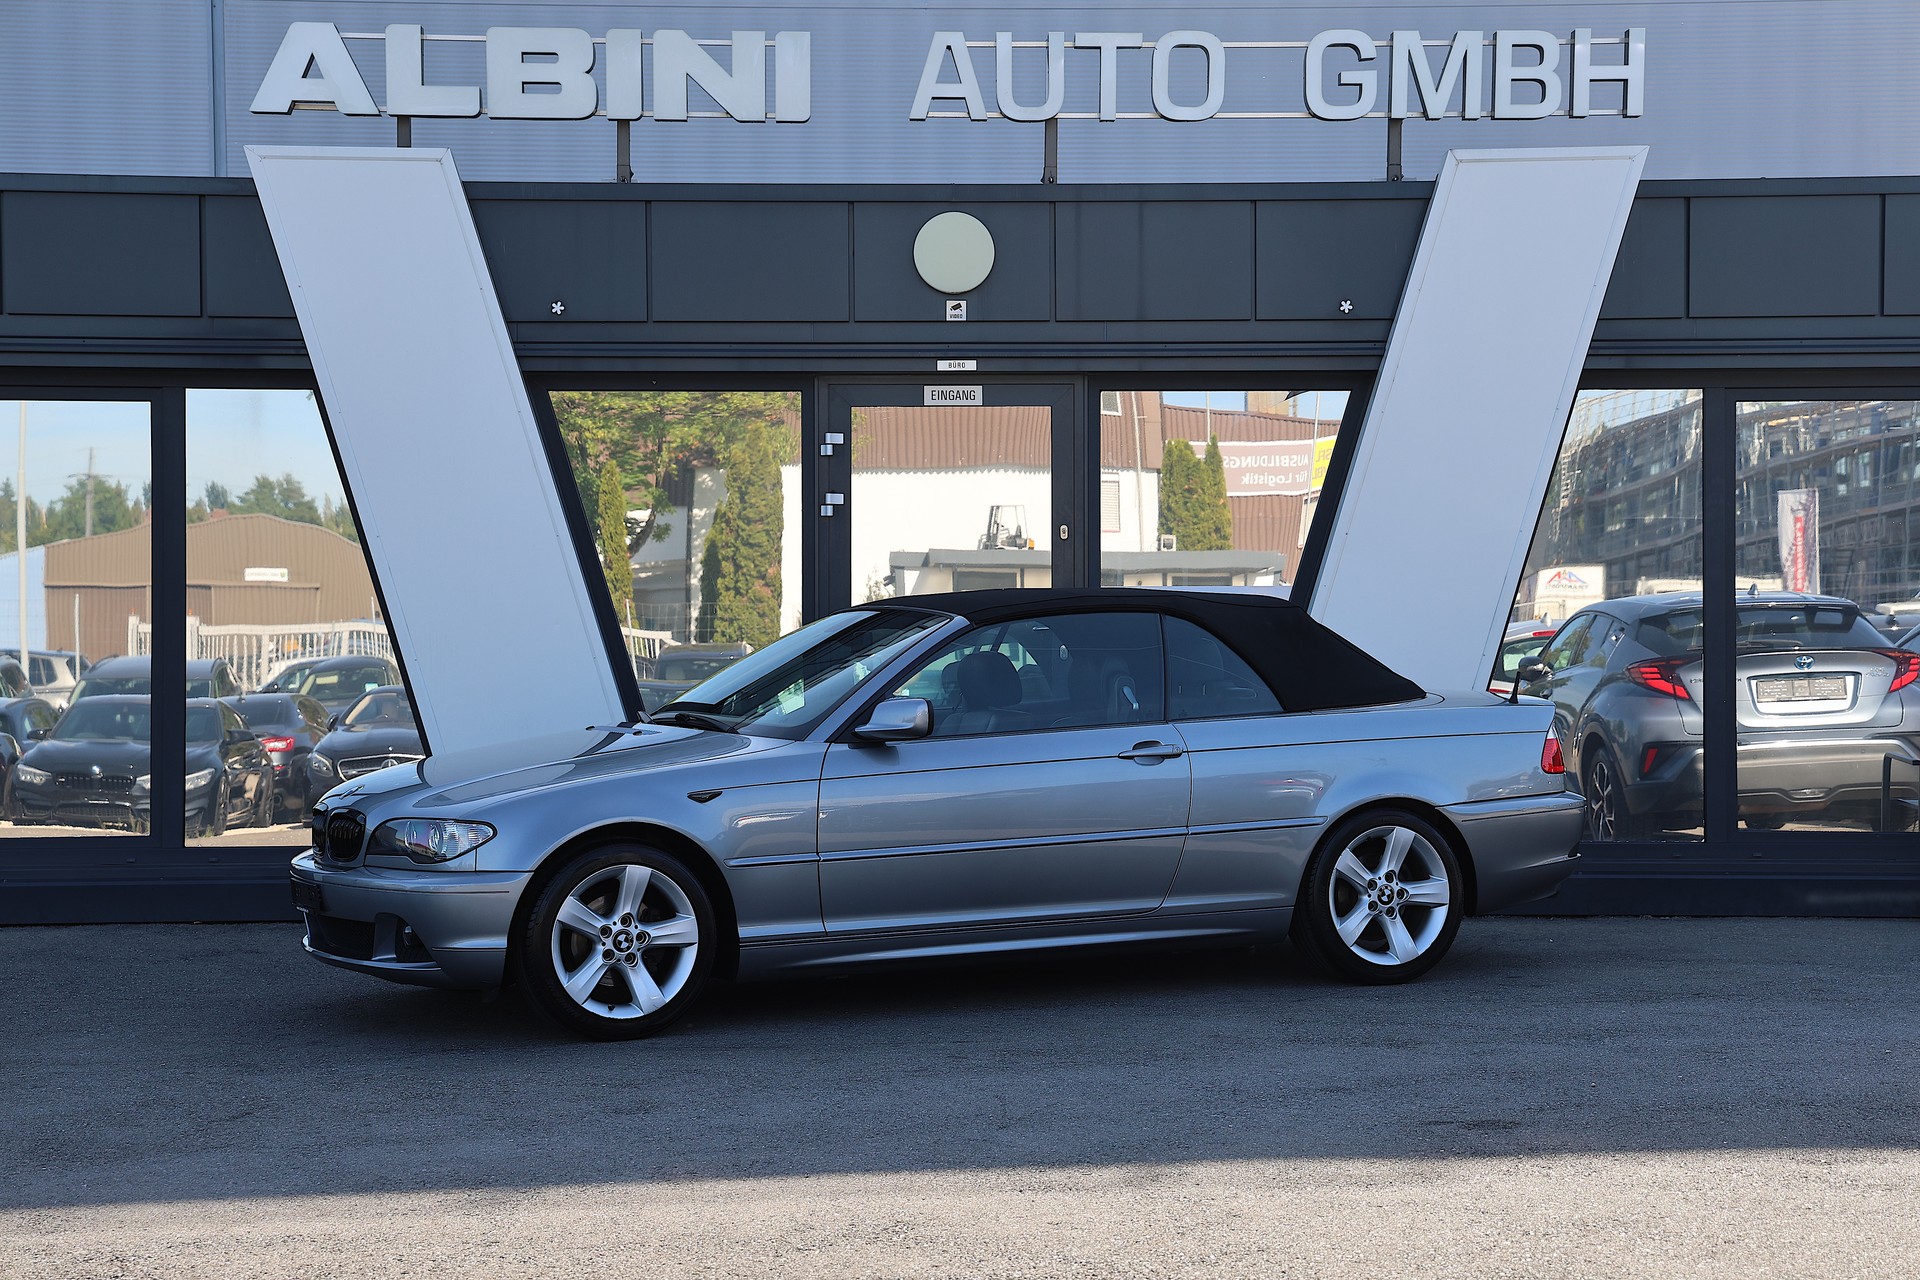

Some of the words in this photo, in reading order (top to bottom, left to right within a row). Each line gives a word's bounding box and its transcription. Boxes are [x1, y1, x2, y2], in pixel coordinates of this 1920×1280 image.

[249, 22, 811, 123] ALBINI
[909, 30, 1226, 122] AUTO
[1305, 27, 1646, 121] GMBH
[948, 361, 966, 369] BÜRO
[931, 389, 976, 401] EINGANG
